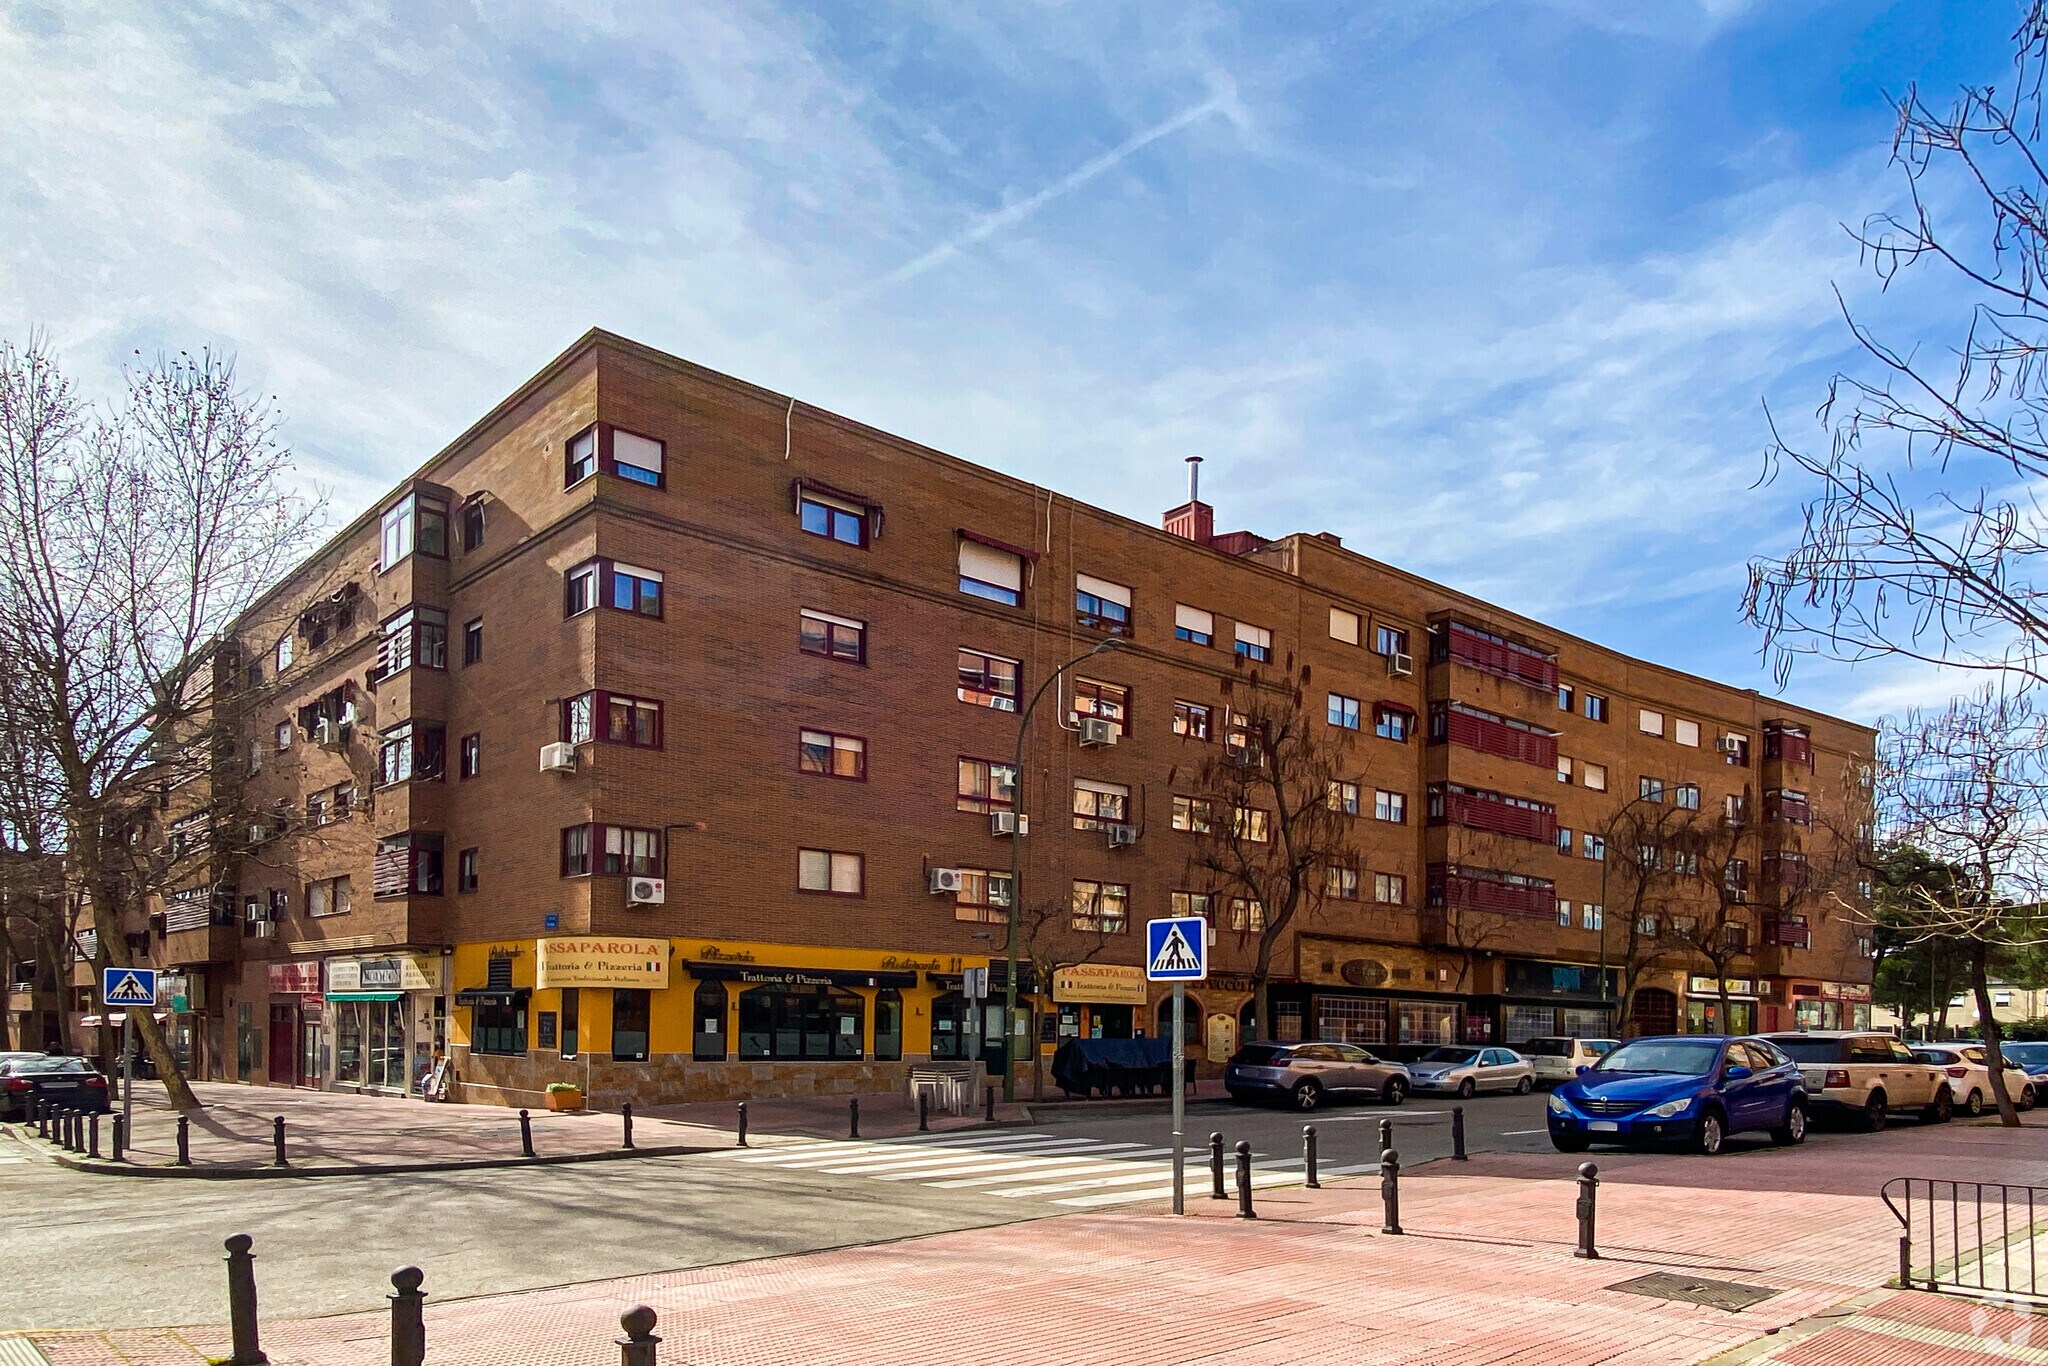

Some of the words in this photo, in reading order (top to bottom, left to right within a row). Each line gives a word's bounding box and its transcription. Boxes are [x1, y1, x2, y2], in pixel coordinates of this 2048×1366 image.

[543, 942, 660, 956] ASSAPAROLA
[598, 961, 642, 972] Pizzeria
[740, 970, 783, 983] Trattoria
[785, 973, 795, 983] &
